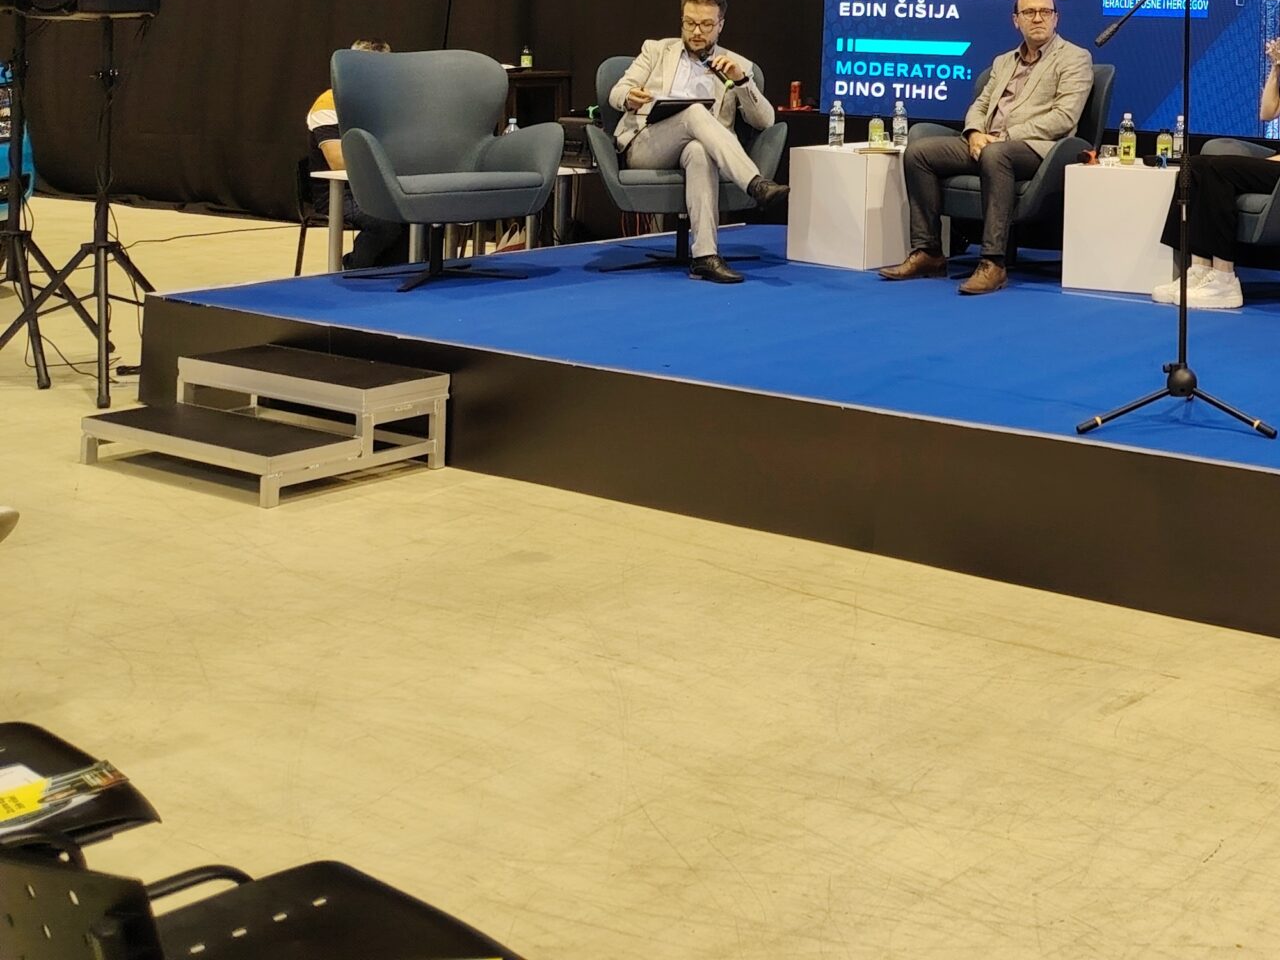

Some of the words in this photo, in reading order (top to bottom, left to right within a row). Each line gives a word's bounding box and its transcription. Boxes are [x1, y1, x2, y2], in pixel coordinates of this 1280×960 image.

[839, 2, 887, 17] EDIN
[894, 0, 960, 19] ČIŠIJA
[835, 60, 972, 80] MODERATOR:
[835, 81, 885, 98] DINO
[892, 81, 948, 101] TIHIĆ
